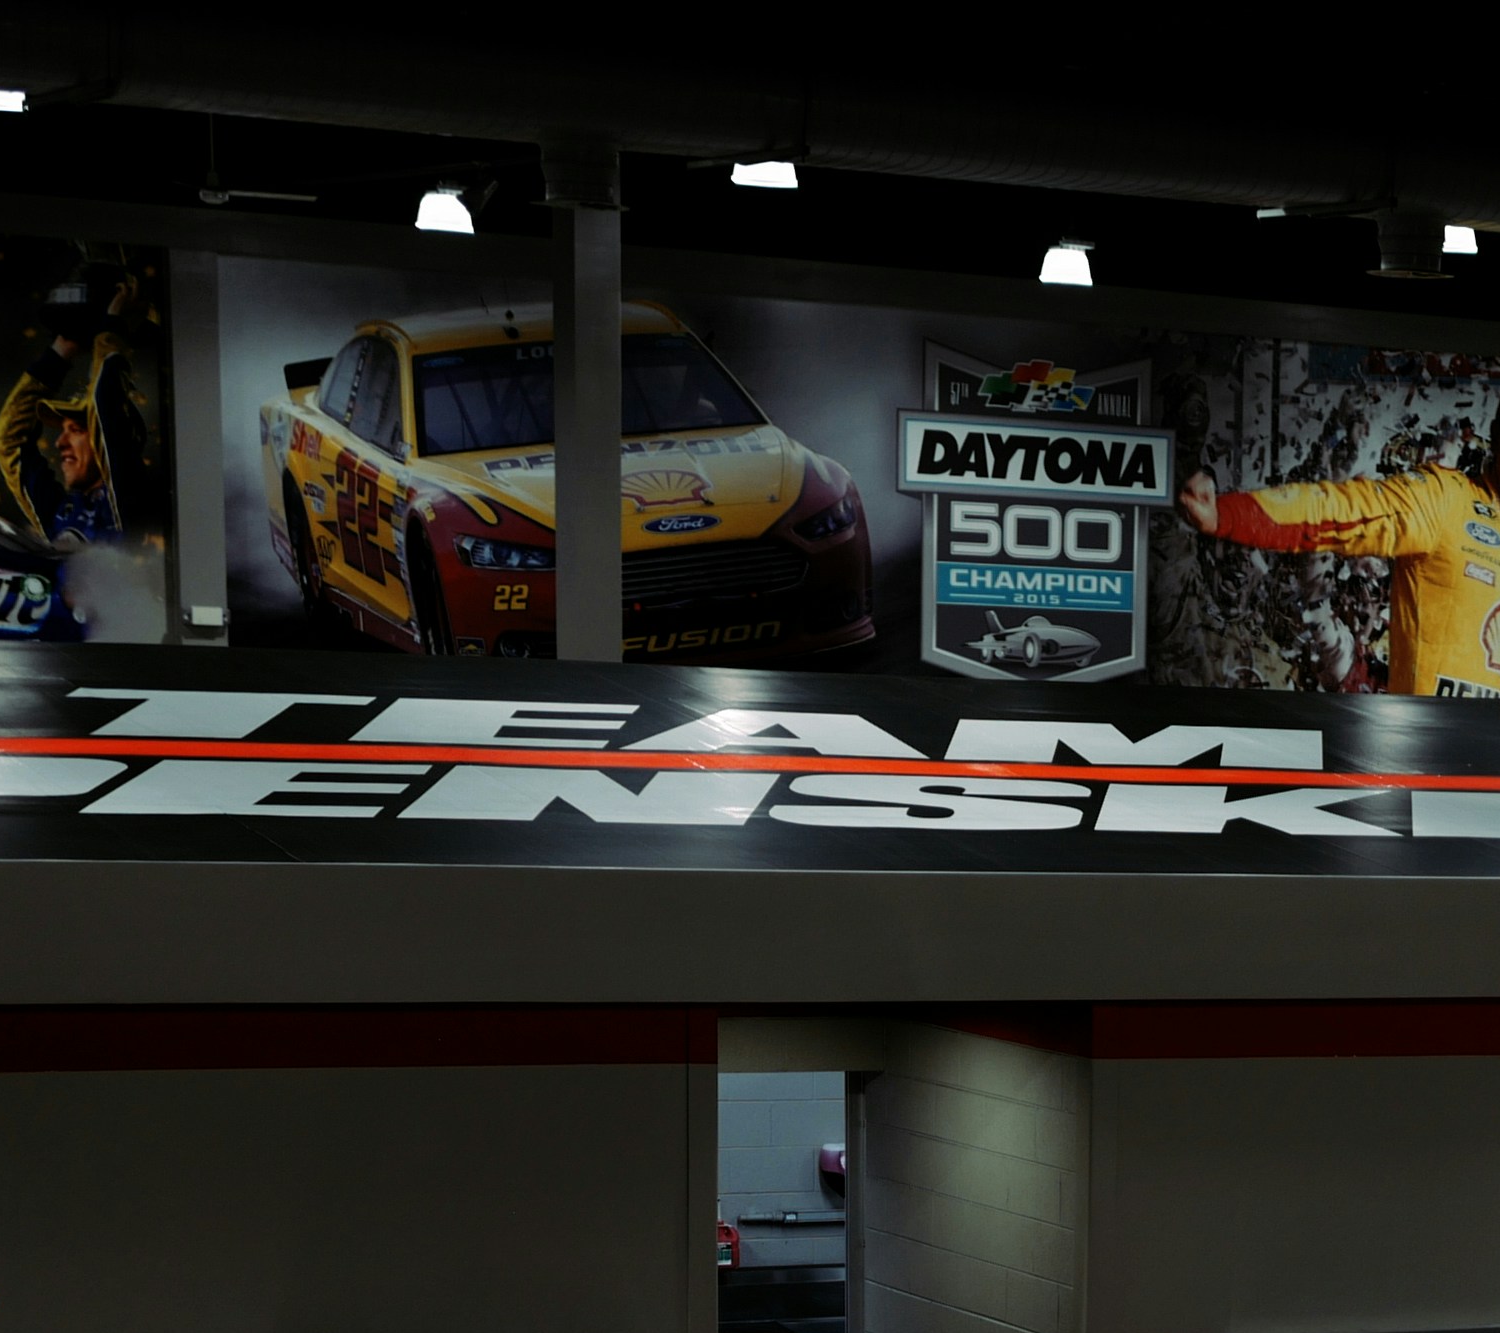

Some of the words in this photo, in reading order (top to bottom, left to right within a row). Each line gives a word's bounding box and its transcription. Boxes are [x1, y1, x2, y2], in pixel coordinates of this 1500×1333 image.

[291, 418, 323, 461] Shell
[918, 429, 1158, 489] DAYTONA
[334, 446, 390, 582] 22
[949, 500, 1124, 564] 500
[493, 583, 529, 612] 22
[949, 567, 1124, 596] CHAMPION
[1012, 592, 1062, 606] 2015
[622, 619, 783, 652] FUSION
[71, 688, 1324, 772] TEAM
